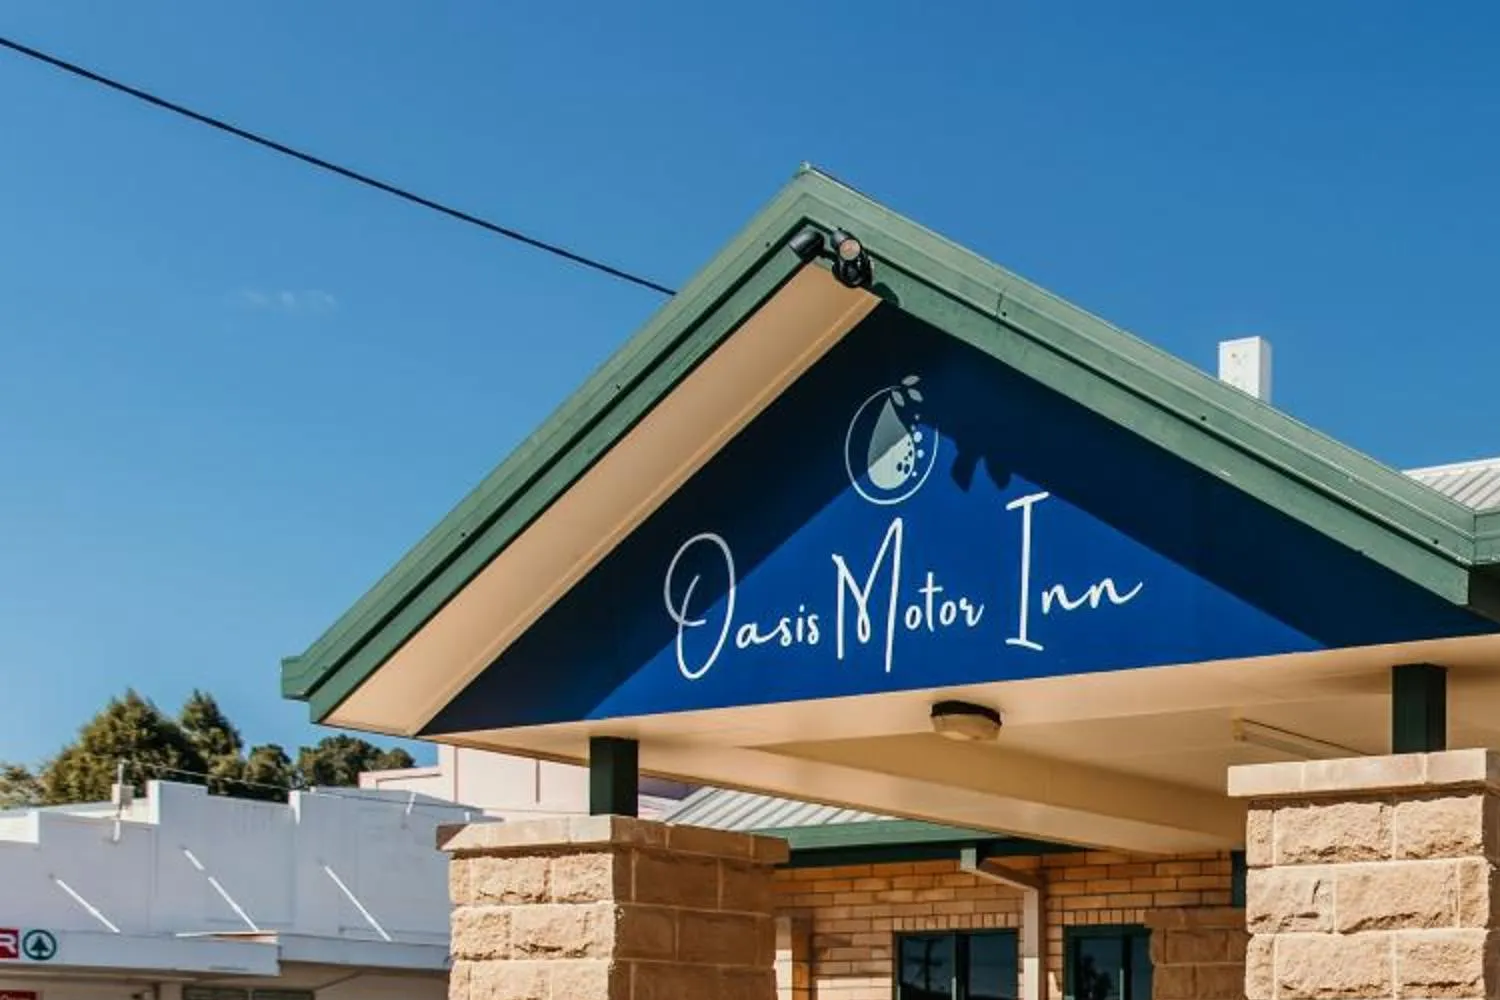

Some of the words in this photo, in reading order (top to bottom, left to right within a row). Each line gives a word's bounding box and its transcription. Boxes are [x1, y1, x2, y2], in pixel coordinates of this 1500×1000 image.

[664, 532, 820, 680] Oasis
[832, 517, 985, 672] Motor
[1005, 491, 1144, 651] Inn
